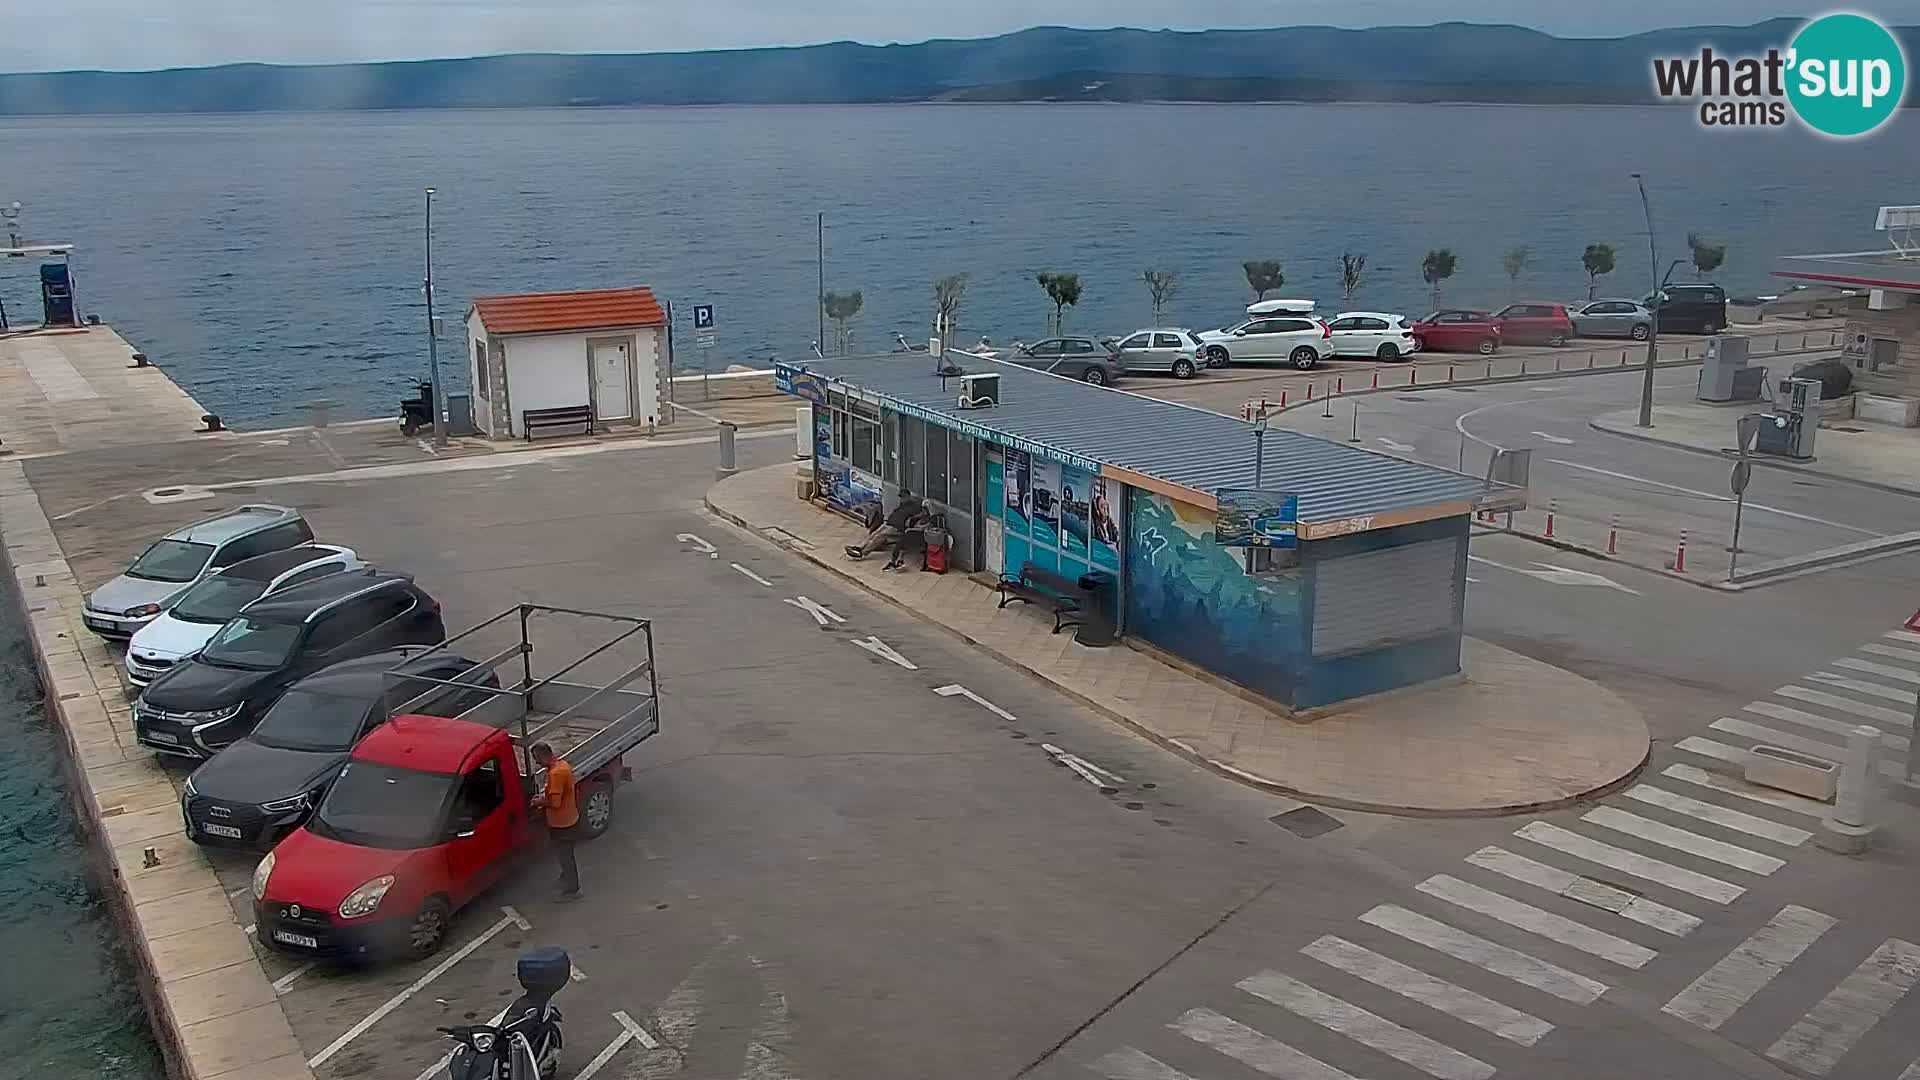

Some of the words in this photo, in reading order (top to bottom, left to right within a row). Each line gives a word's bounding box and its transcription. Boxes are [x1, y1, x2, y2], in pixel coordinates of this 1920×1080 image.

[698, 308, 709, 325] P
[962, 423, 991, 440] POSTAJA
[1000, 434, 1014, 447] BUS
[1015, 438, 1045, 456] STATION
[1046, 450, 1071, 464] TICKET
[1072, 456, 1098, 472] OFFICE
